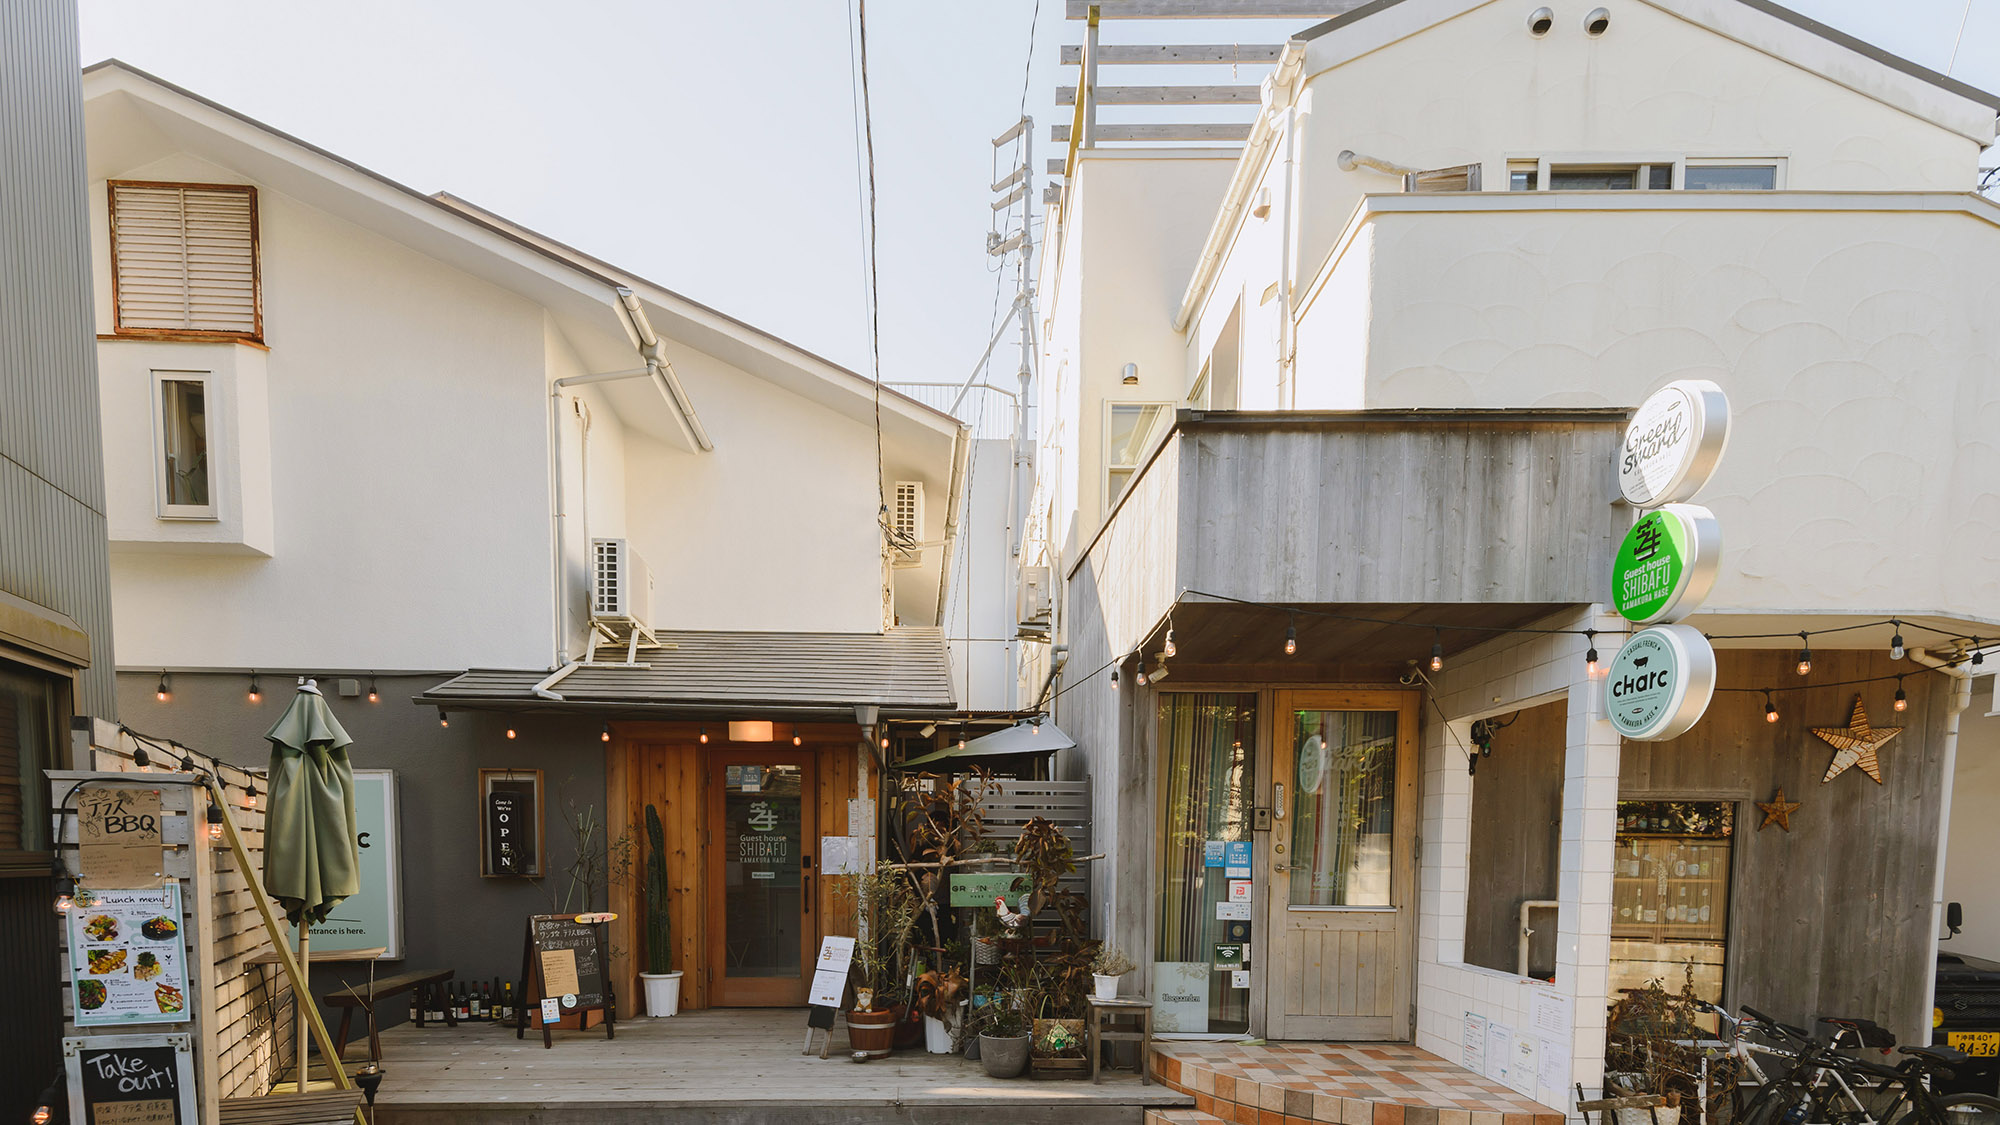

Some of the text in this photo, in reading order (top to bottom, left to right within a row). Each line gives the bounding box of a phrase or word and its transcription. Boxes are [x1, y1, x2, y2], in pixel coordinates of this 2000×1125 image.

[1626, 416, 1679, 453] Green
[1623, 555, 1671, 581] Guest house
[1622, 563, 1671, 601] SHIBAFU
[1622, 585, 1670, 611] KAMAKURA HASE
[1626, 640, 1658, 656] CASUAL FRENCH
[1621, 710, 1655, 728] KAMAKURA HASE
[87, 798, 128, 817] テラス
[104, 814, 159, 834] BBQ
[499, 813, 511, 866] OPEN
[740, 834, 787, 842] Guest house
[739, 841, 787, 857] SHIBAFU
[308, 927, 366, 935] ntrance is here.
[1958, 1042, 1997, 1055] 84-36
[86, 1052, 148, 1079] Take
[118, 1066, 175, 1093] out!
